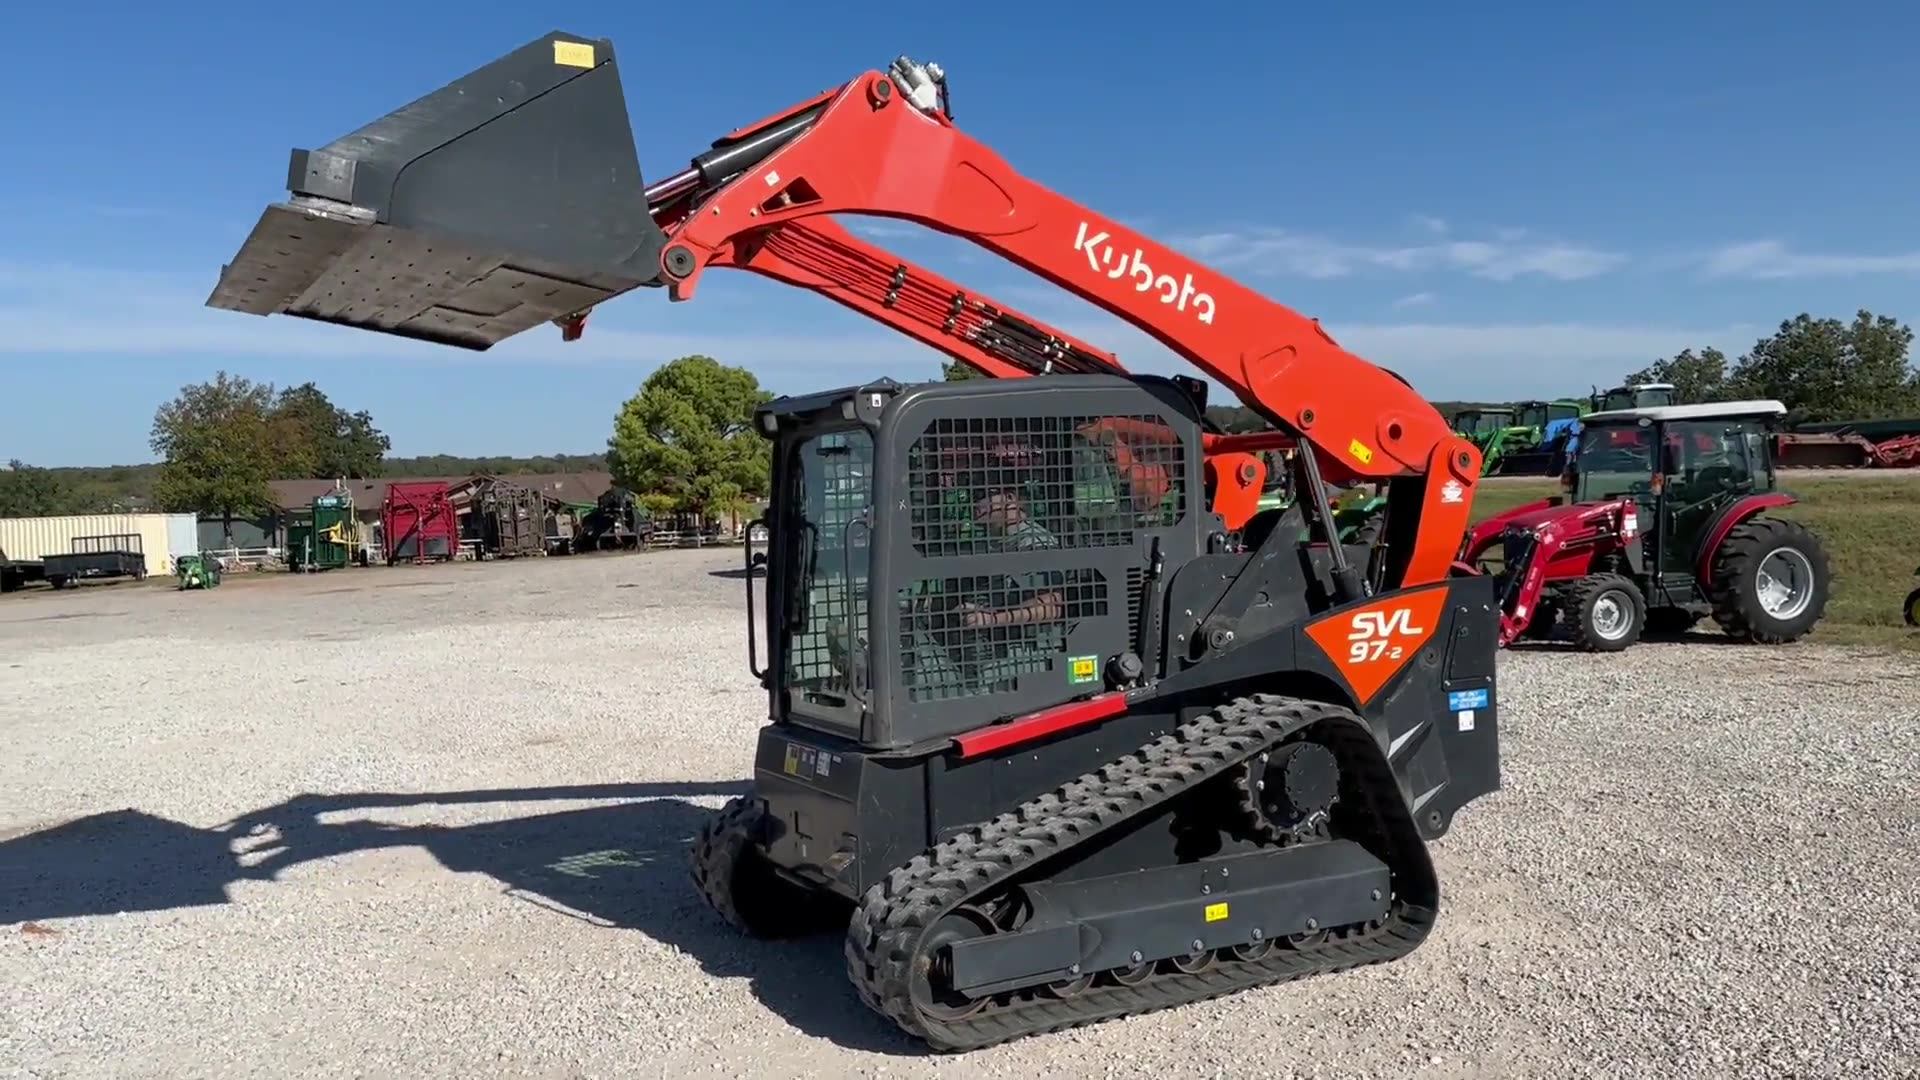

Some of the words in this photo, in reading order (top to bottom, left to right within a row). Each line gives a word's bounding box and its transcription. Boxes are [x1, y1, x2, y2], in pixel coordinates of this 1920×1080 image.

[1074, 221, 1216, 325] Kubota
[1348, 608, 1423, 641] SVL
[1348, 639, 1403, 664] 97-2
